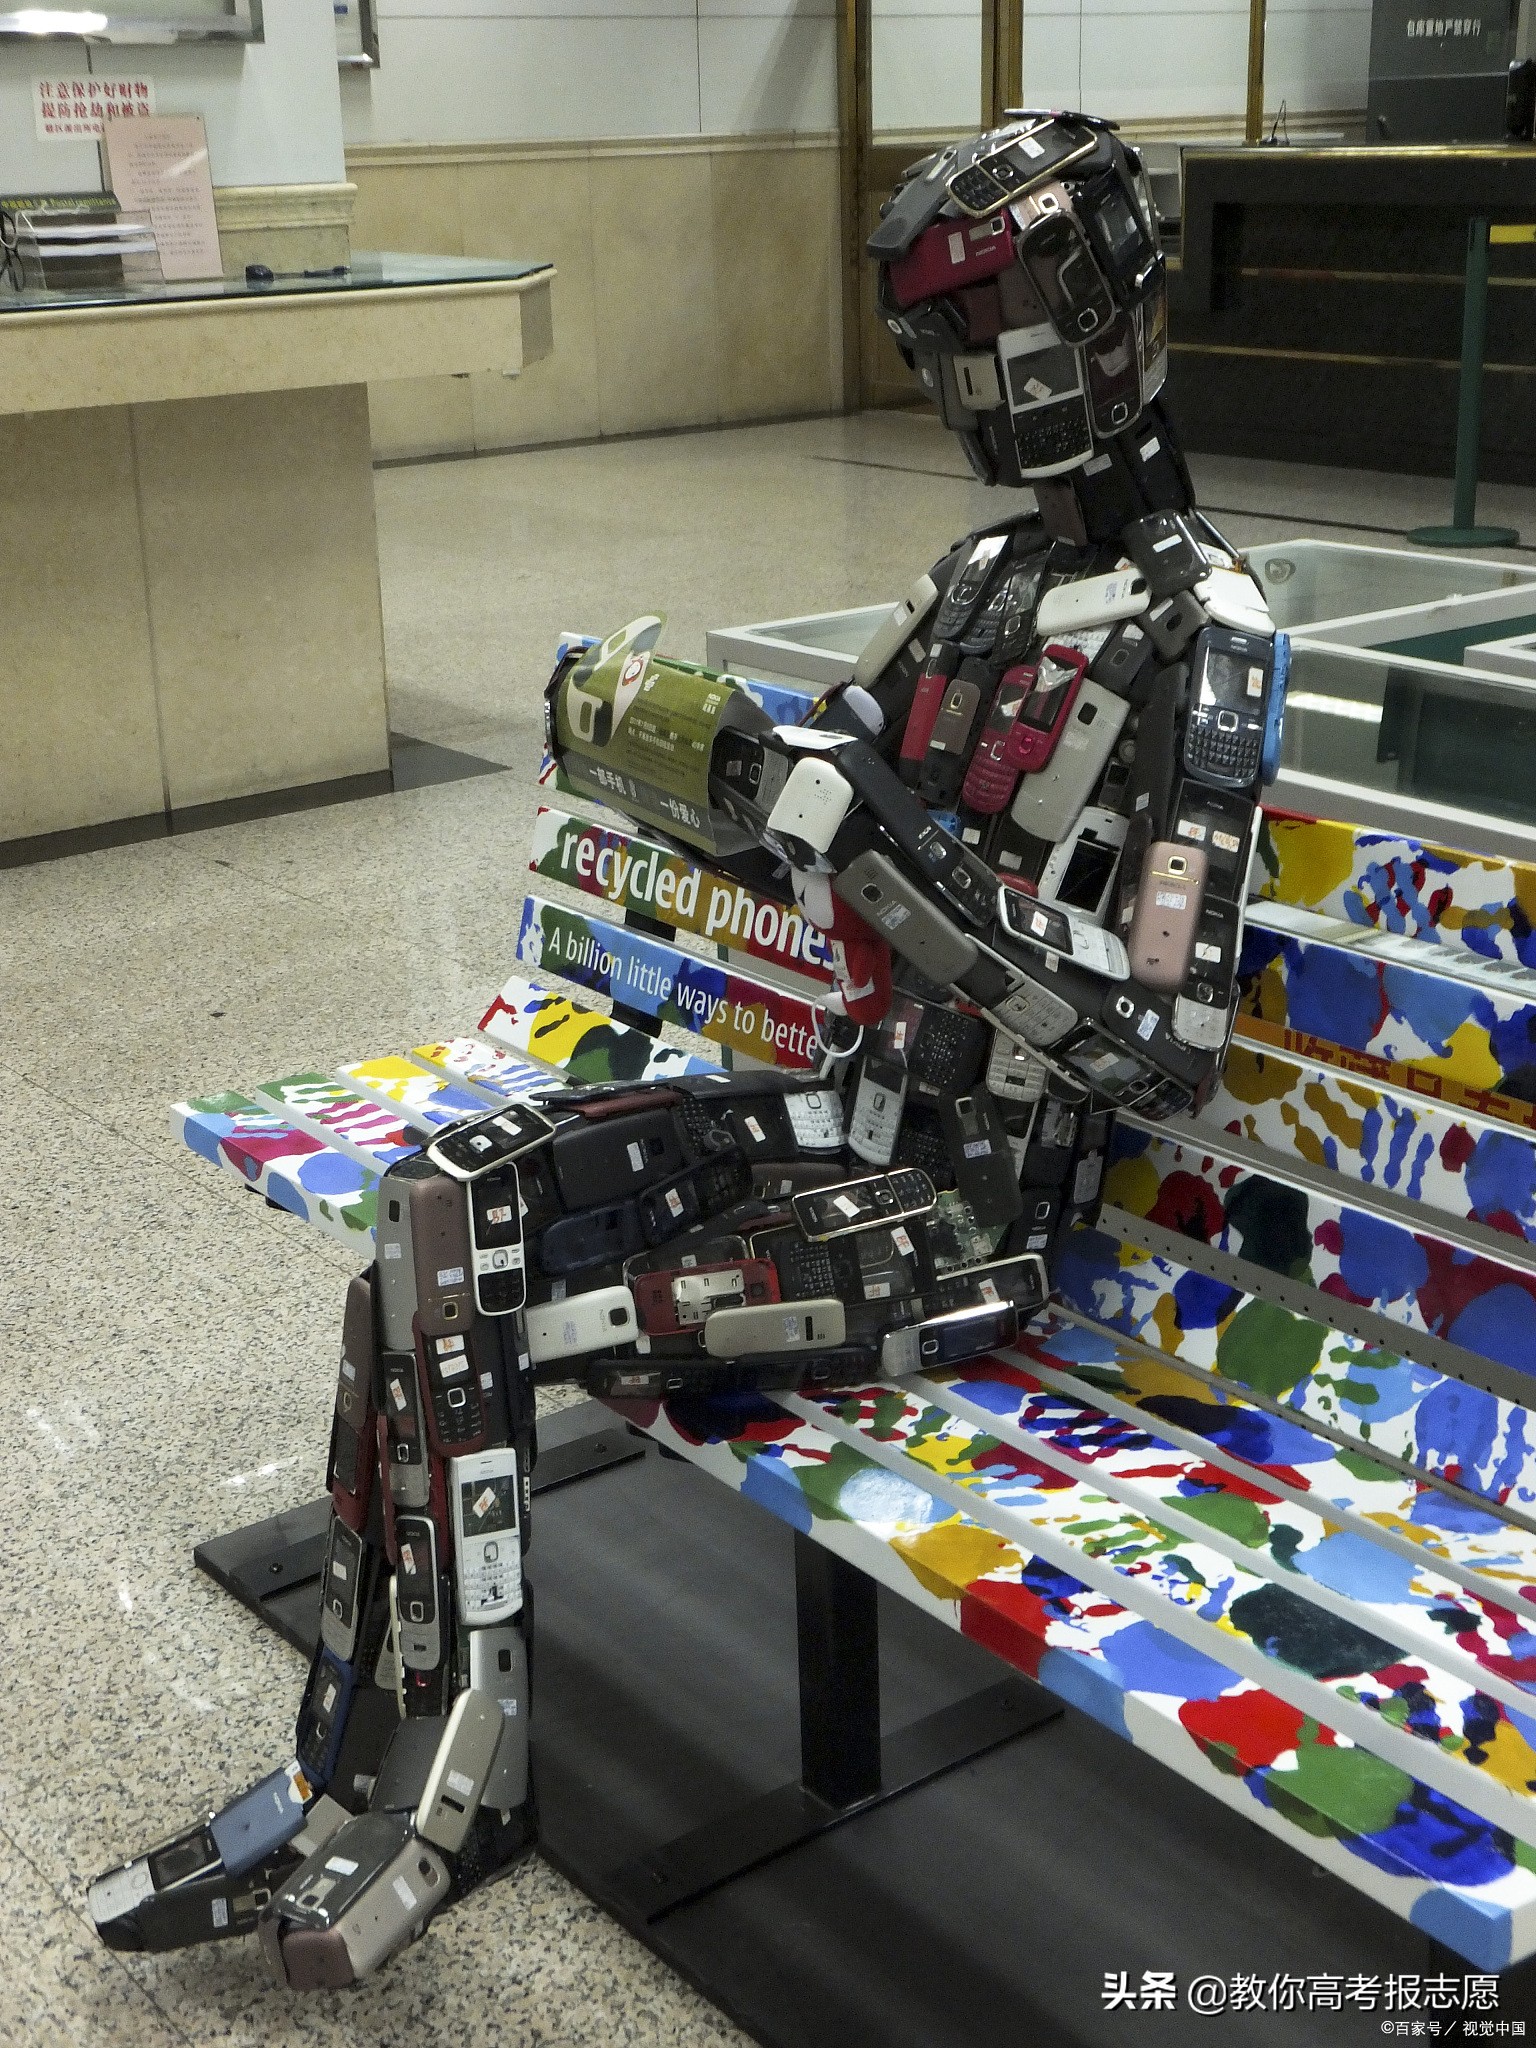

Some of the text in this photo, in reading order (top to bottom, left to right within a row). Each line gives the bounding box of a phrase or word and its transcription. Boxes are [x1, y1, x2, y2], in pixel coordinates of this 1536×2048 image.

[560, 830, 834, 971] recycled phone
[548, 926, 560, 956] A
[566, 930, 623, 979] billion
[627, 952, 672, 1000] little
[676, 982, 729, 1026] ways
[733, 1001, 755, 1034] to
